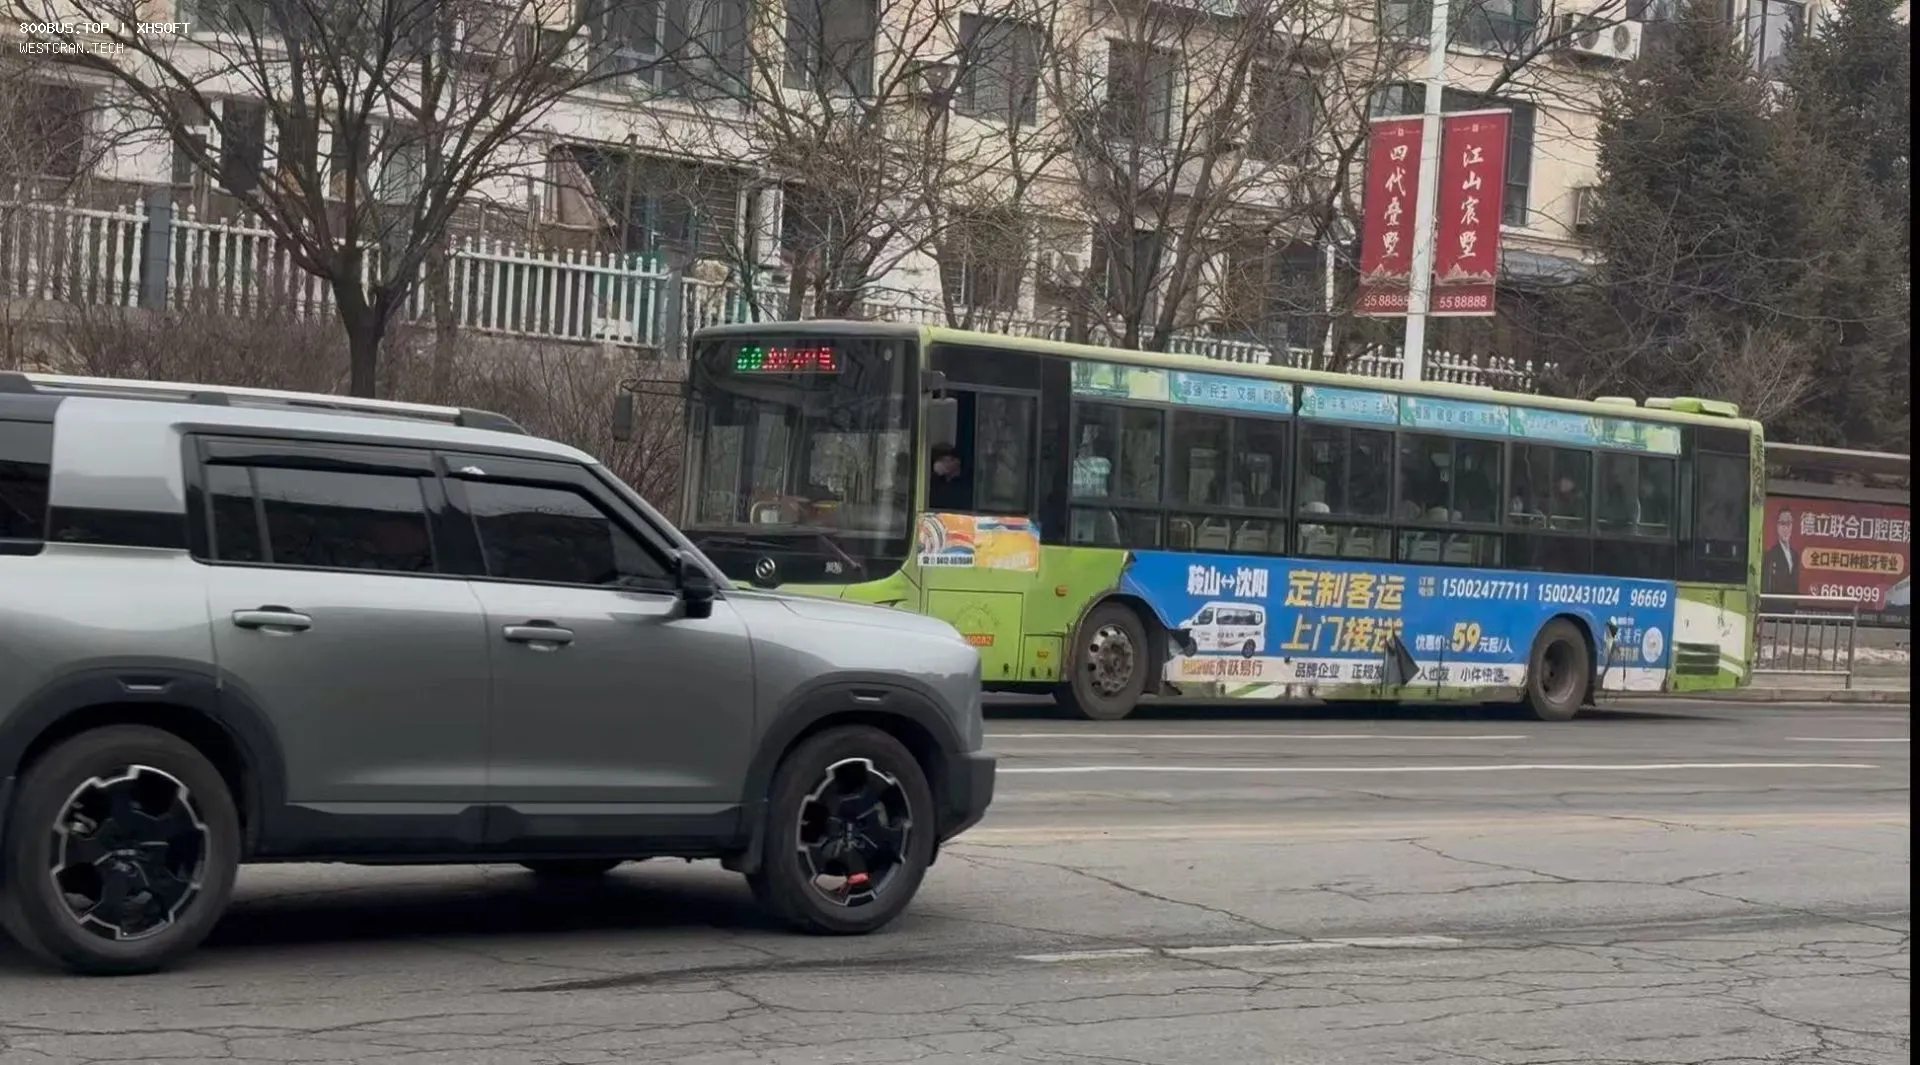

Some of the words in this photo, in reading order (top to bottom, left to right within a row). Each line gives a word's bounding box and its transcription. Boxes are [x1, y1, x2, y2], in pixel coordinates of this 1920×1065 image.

[1459, 144, 1484, 260] 江山宸墅
[1810, 551, 1898, 571] 全口半口种植牙专业
[1234, 566, 1269, 598] 沈阳
[1284, 569, 1405, 611] 定制客运
[1441, 578, 1528, 601] 15002477711
[1537, 583, 1620, 607] 15002431024
[1630, 588, 1667, 609] 96669
[1280, 613, 1405, 654] 上门接送
[1295, 662, 1339, 679] 品牌企业
